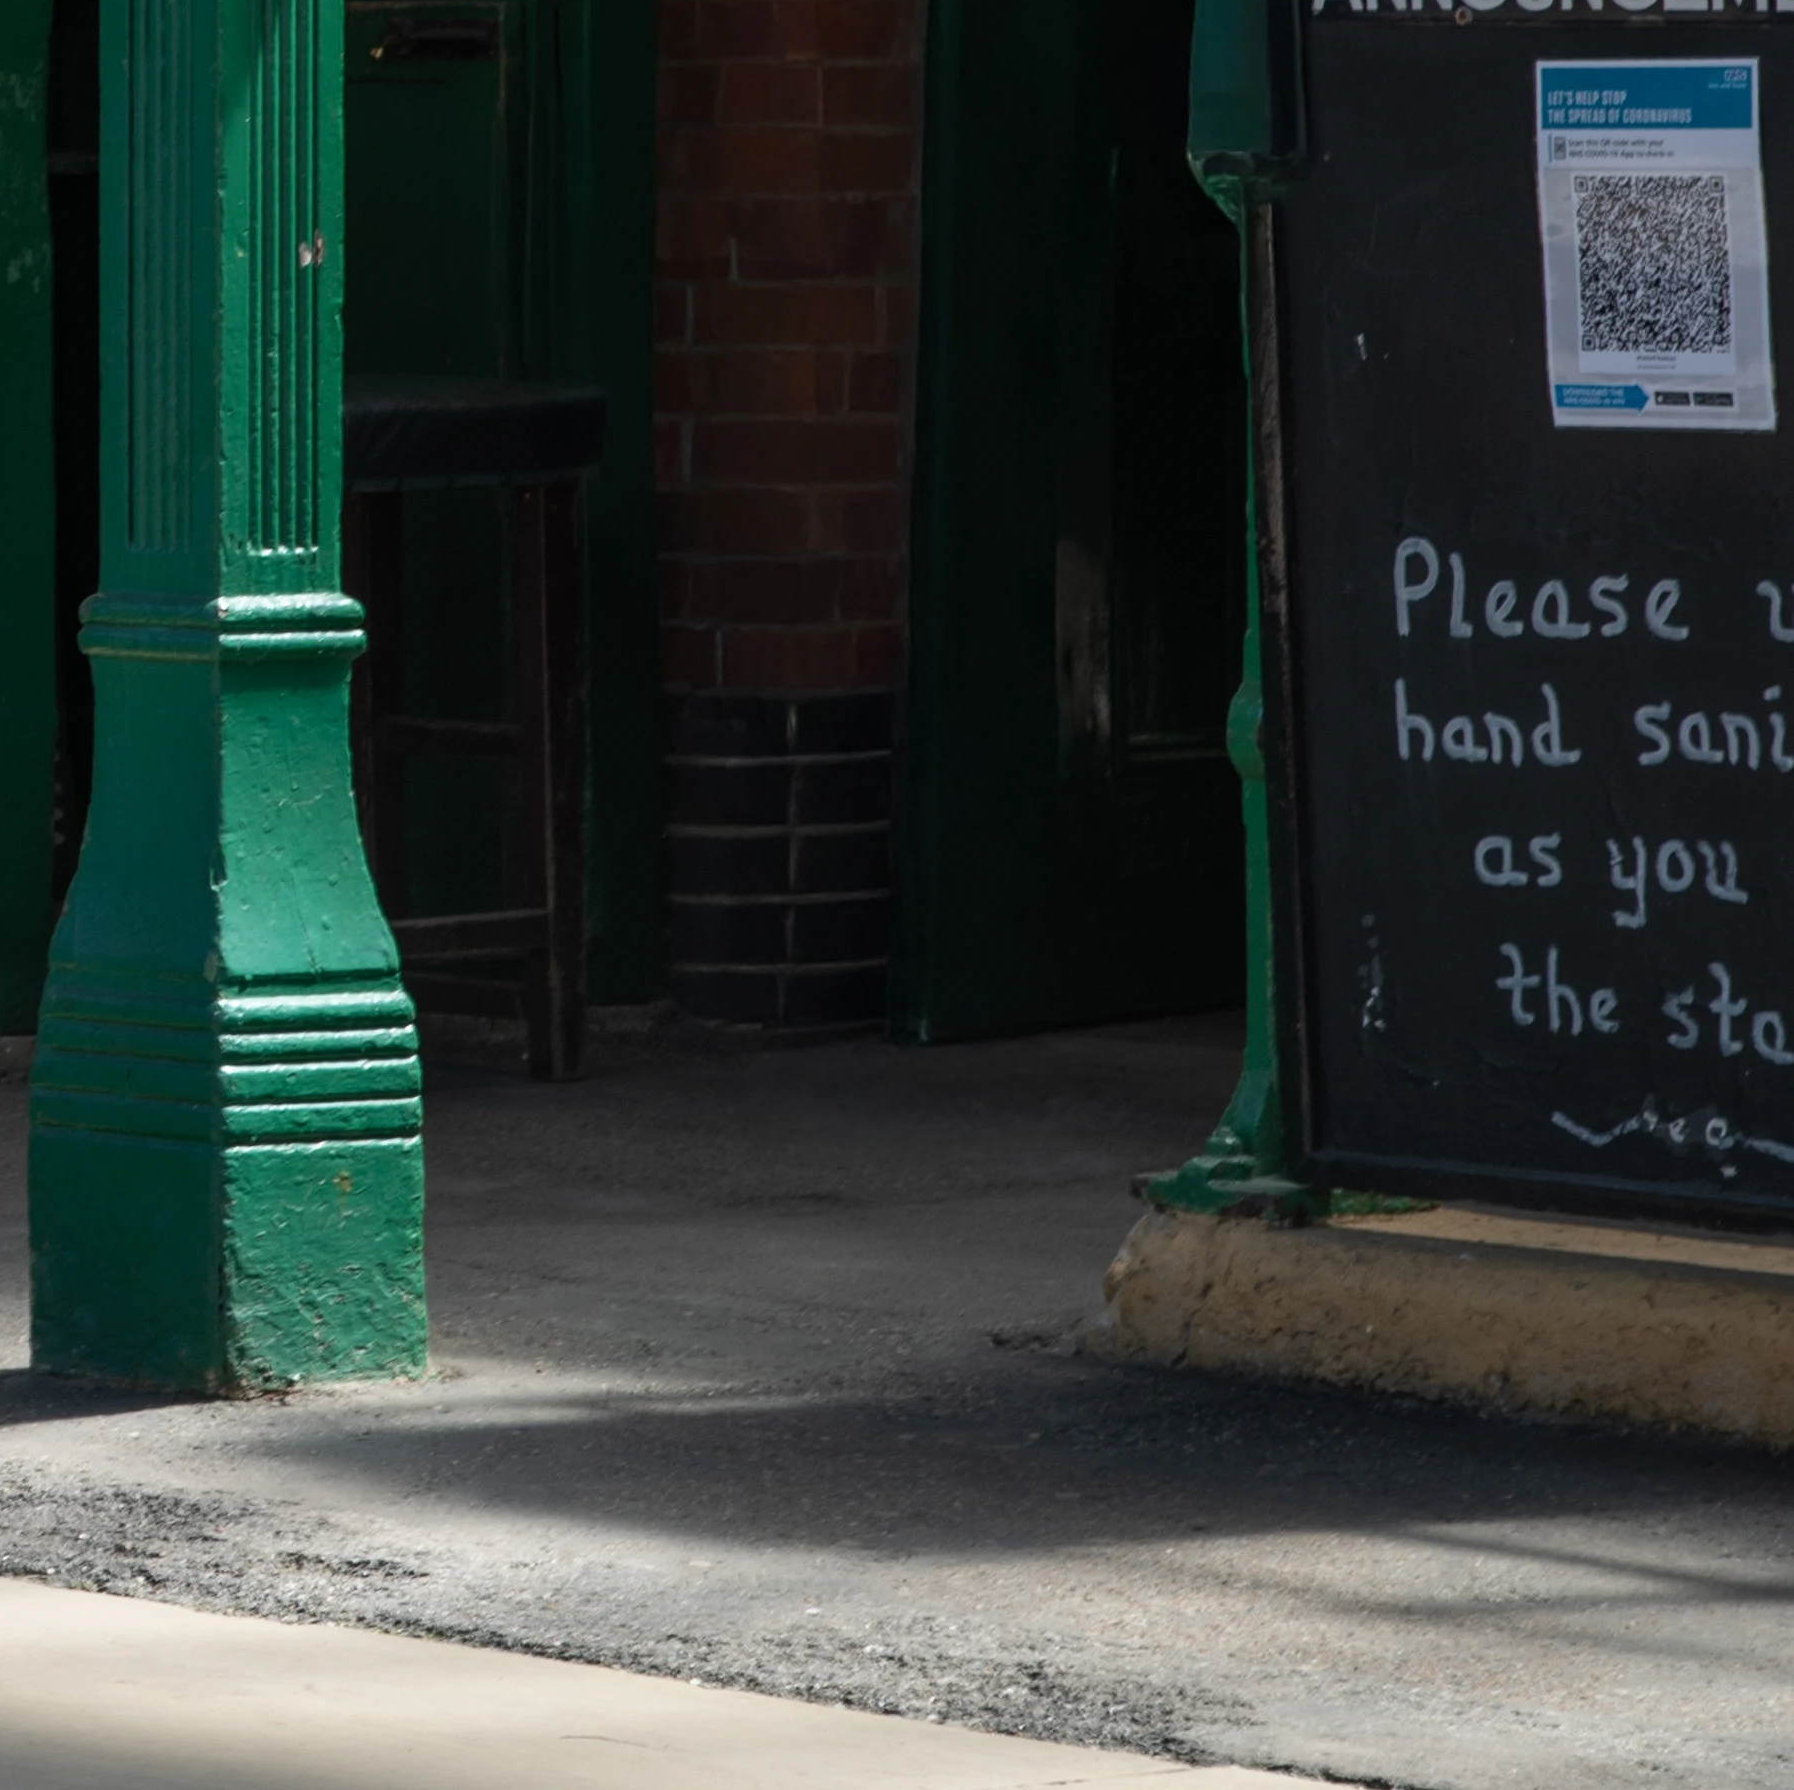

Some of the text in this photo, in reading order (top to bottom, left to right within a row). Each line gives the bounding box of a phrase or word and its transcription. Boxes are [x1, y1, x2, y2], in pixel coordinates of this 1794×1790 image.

[1393, 536, 1690, 641] Please
[1396, 678, 1582, 768] hand
[1473, 833, 1749, 928] as you
[1496, 942, 1619, 1035] the
